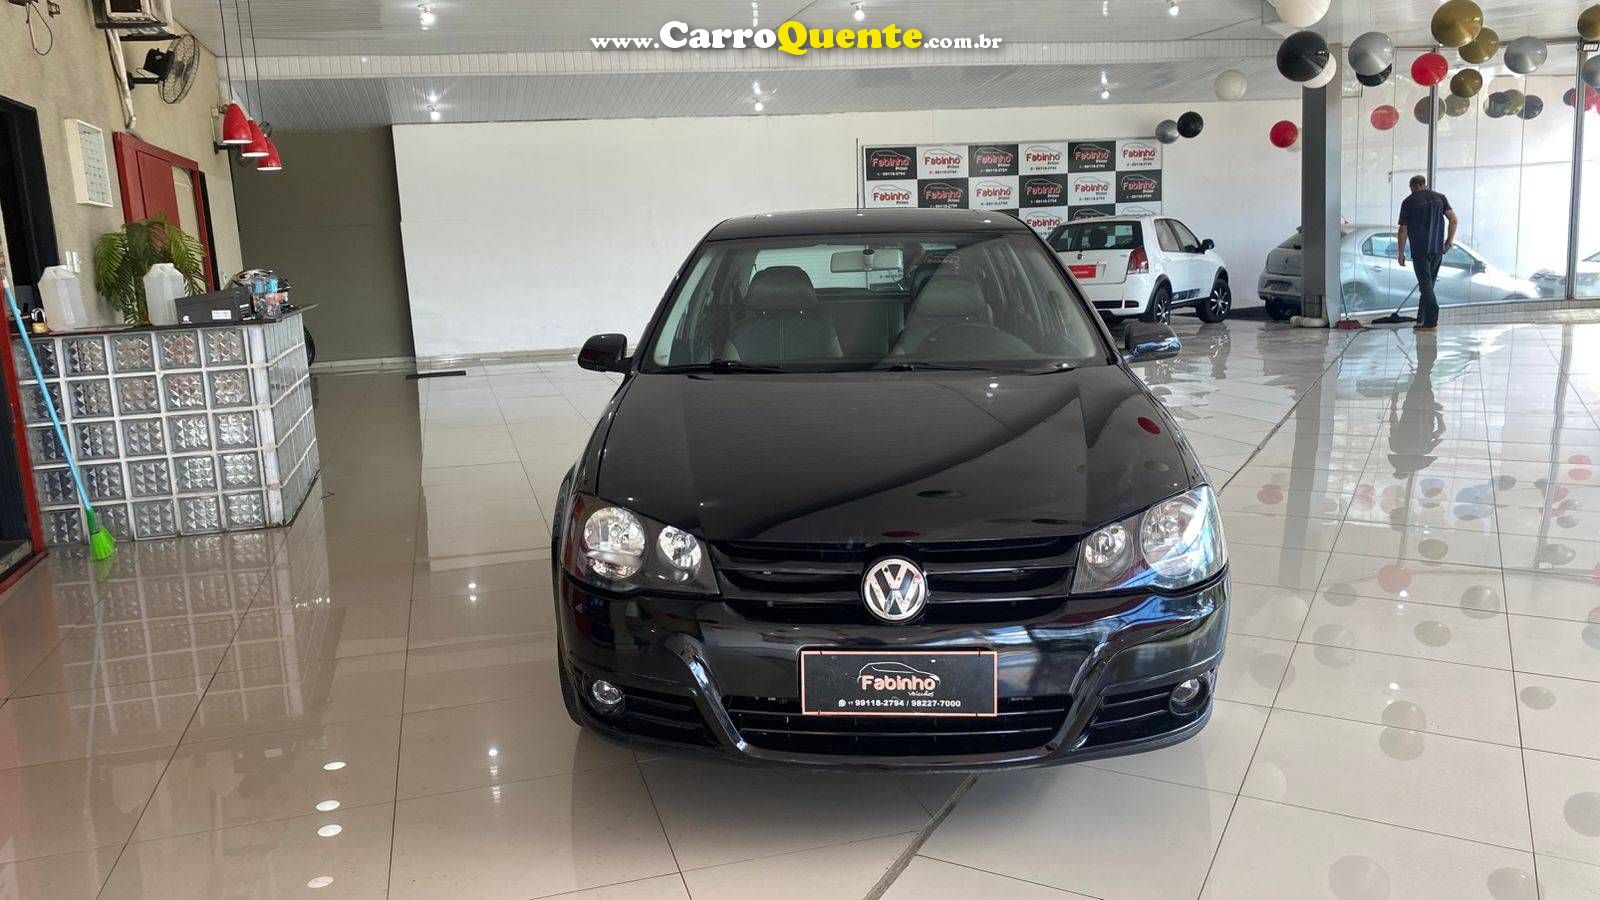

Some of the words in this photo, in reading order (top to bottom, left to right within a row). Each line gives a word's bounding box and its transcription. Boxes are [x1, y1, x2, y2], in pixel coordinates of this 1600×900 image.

[1026, 153, 1060, 161] Fabinho
[1075, 151, 1109, 160] Fabinho
[1123, 149, 1156, 158] Fabinho
[872, 158, 910, 167] Fabinho
[924, 156, 961, 165] Fabinho
[976, 155, 1012, 164] Fabinho
[1026, 185, 1061, 195] Fabinho
[1075, 184, 1109, 192] Fabinho
[1123, 181, 1156, 190] Fabinho
[873, 192, 911, 201] Fabinho
[925, 190, 962, 200] Fabinho
[976, 188, 1012, 197] Fabinho
[861, 675, 936, 691] Fabinho
[855, 699, 904, 707] 99118-2794
